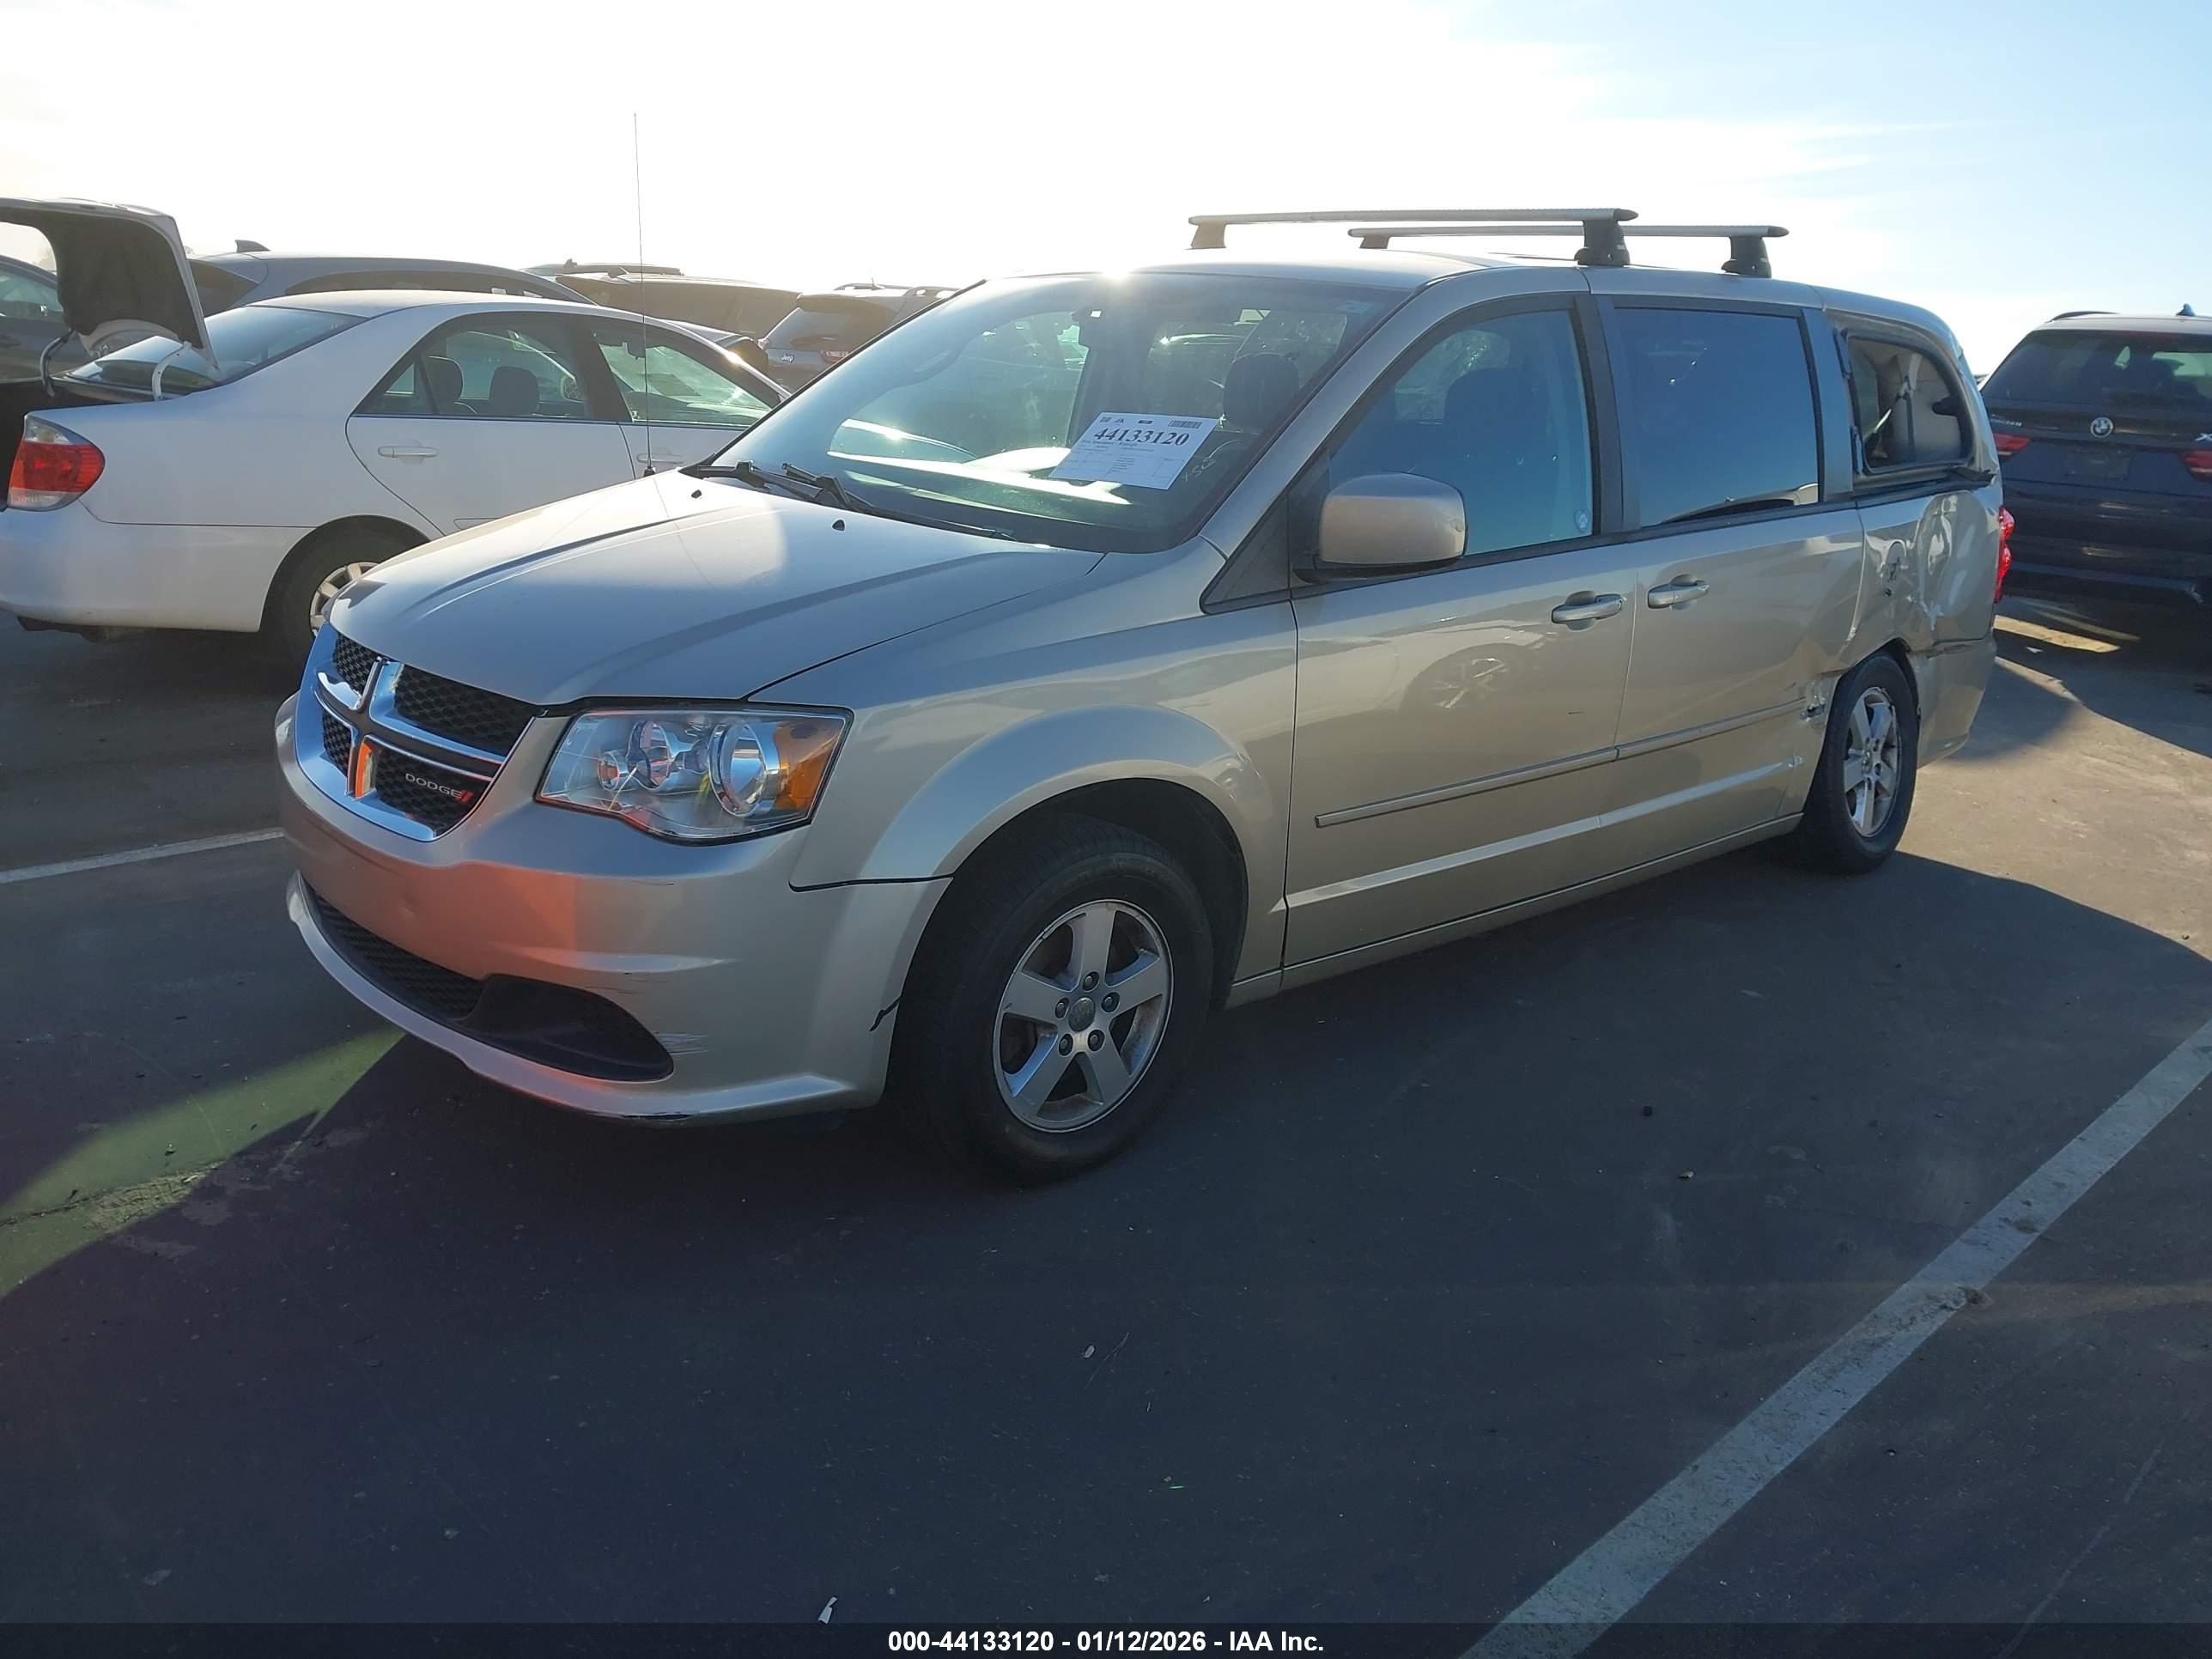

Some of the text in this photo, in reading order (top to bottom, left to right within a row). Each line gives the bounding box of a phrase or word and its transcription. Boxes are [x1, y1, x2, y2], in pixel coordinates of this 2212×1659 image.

[781, 353, 794, 363] Jeep
[1094, 428, 1190, 446] 44133120
[405, 773, 462, 799] DODGE
